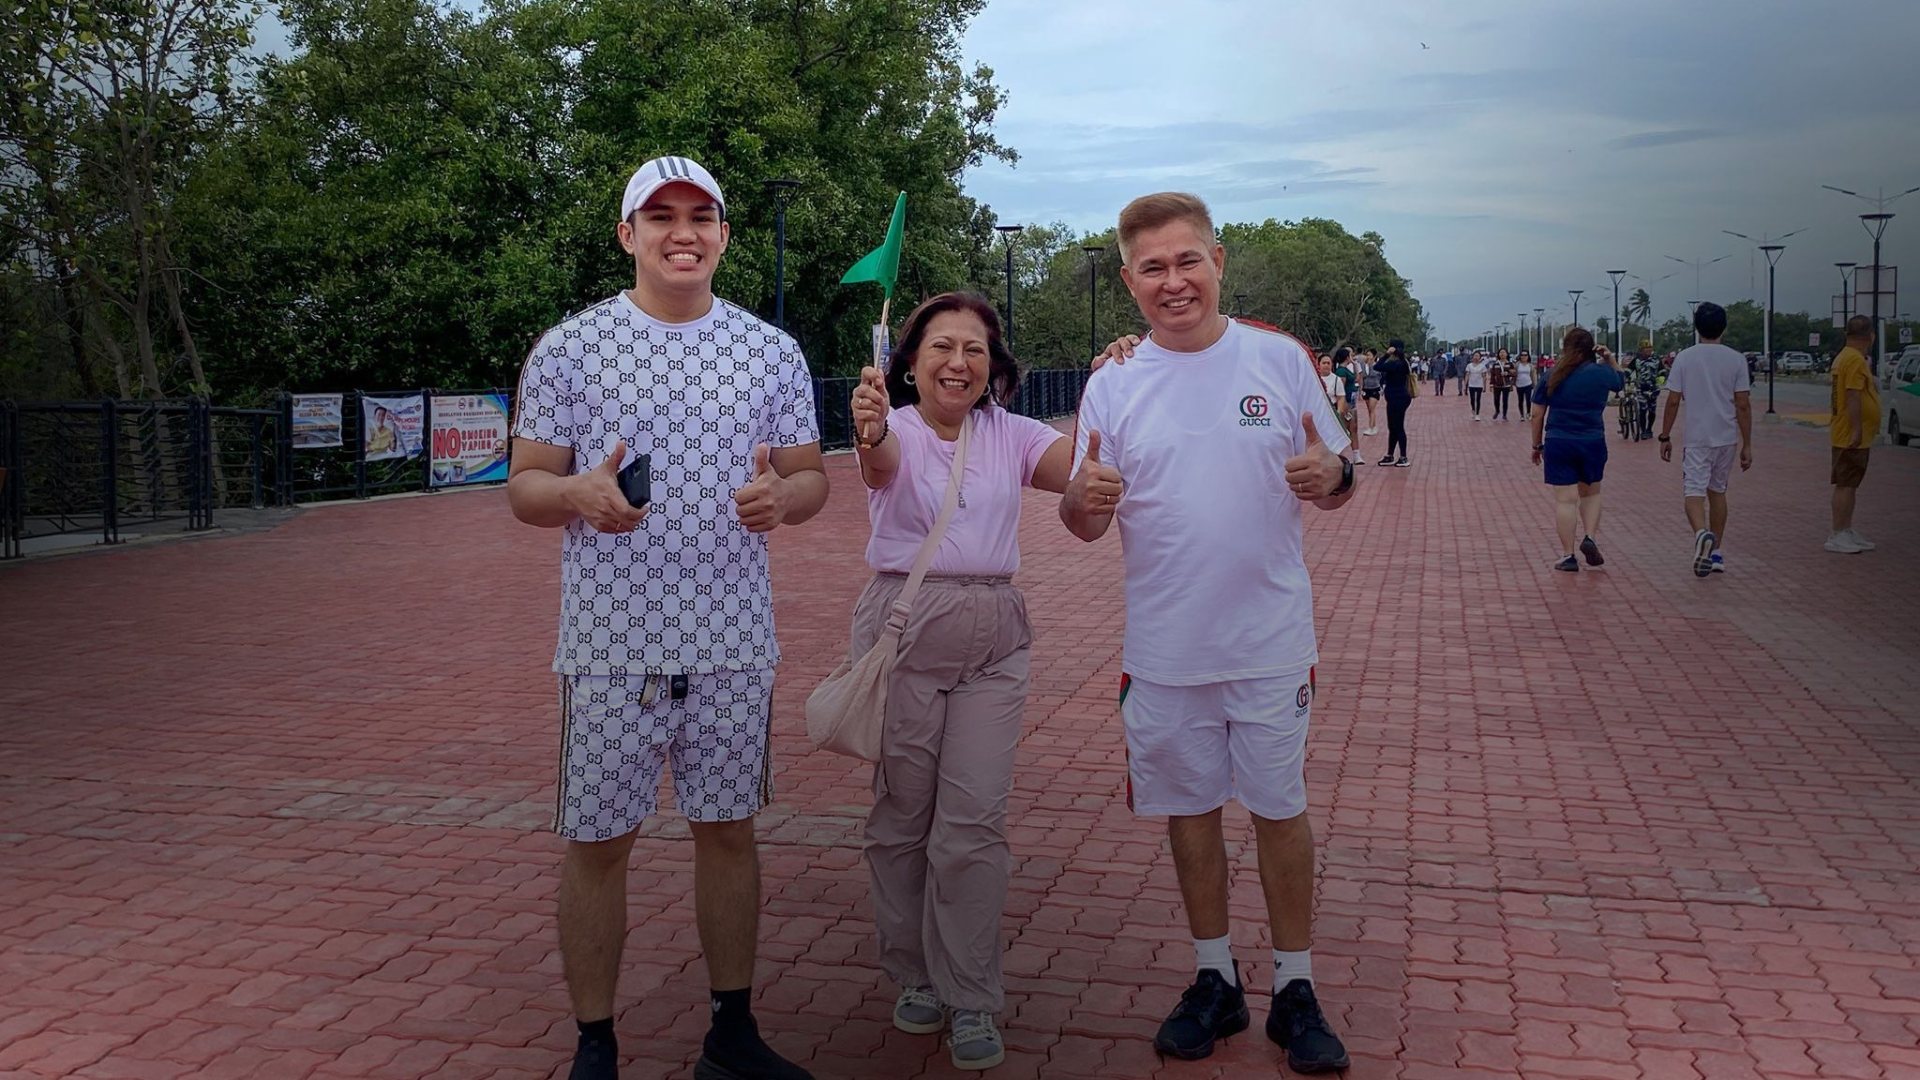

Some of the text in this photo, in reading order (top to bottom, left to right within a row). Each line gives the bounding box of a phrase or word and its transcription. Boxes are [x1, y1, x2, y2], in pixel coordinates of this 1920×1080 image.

[1239, 418, 1271, 427] GUCCI
[461, 428, 498, 440] SMOKING
[433, 427, 461, 459] NO
[461, 439, 491, 451] VAPING
